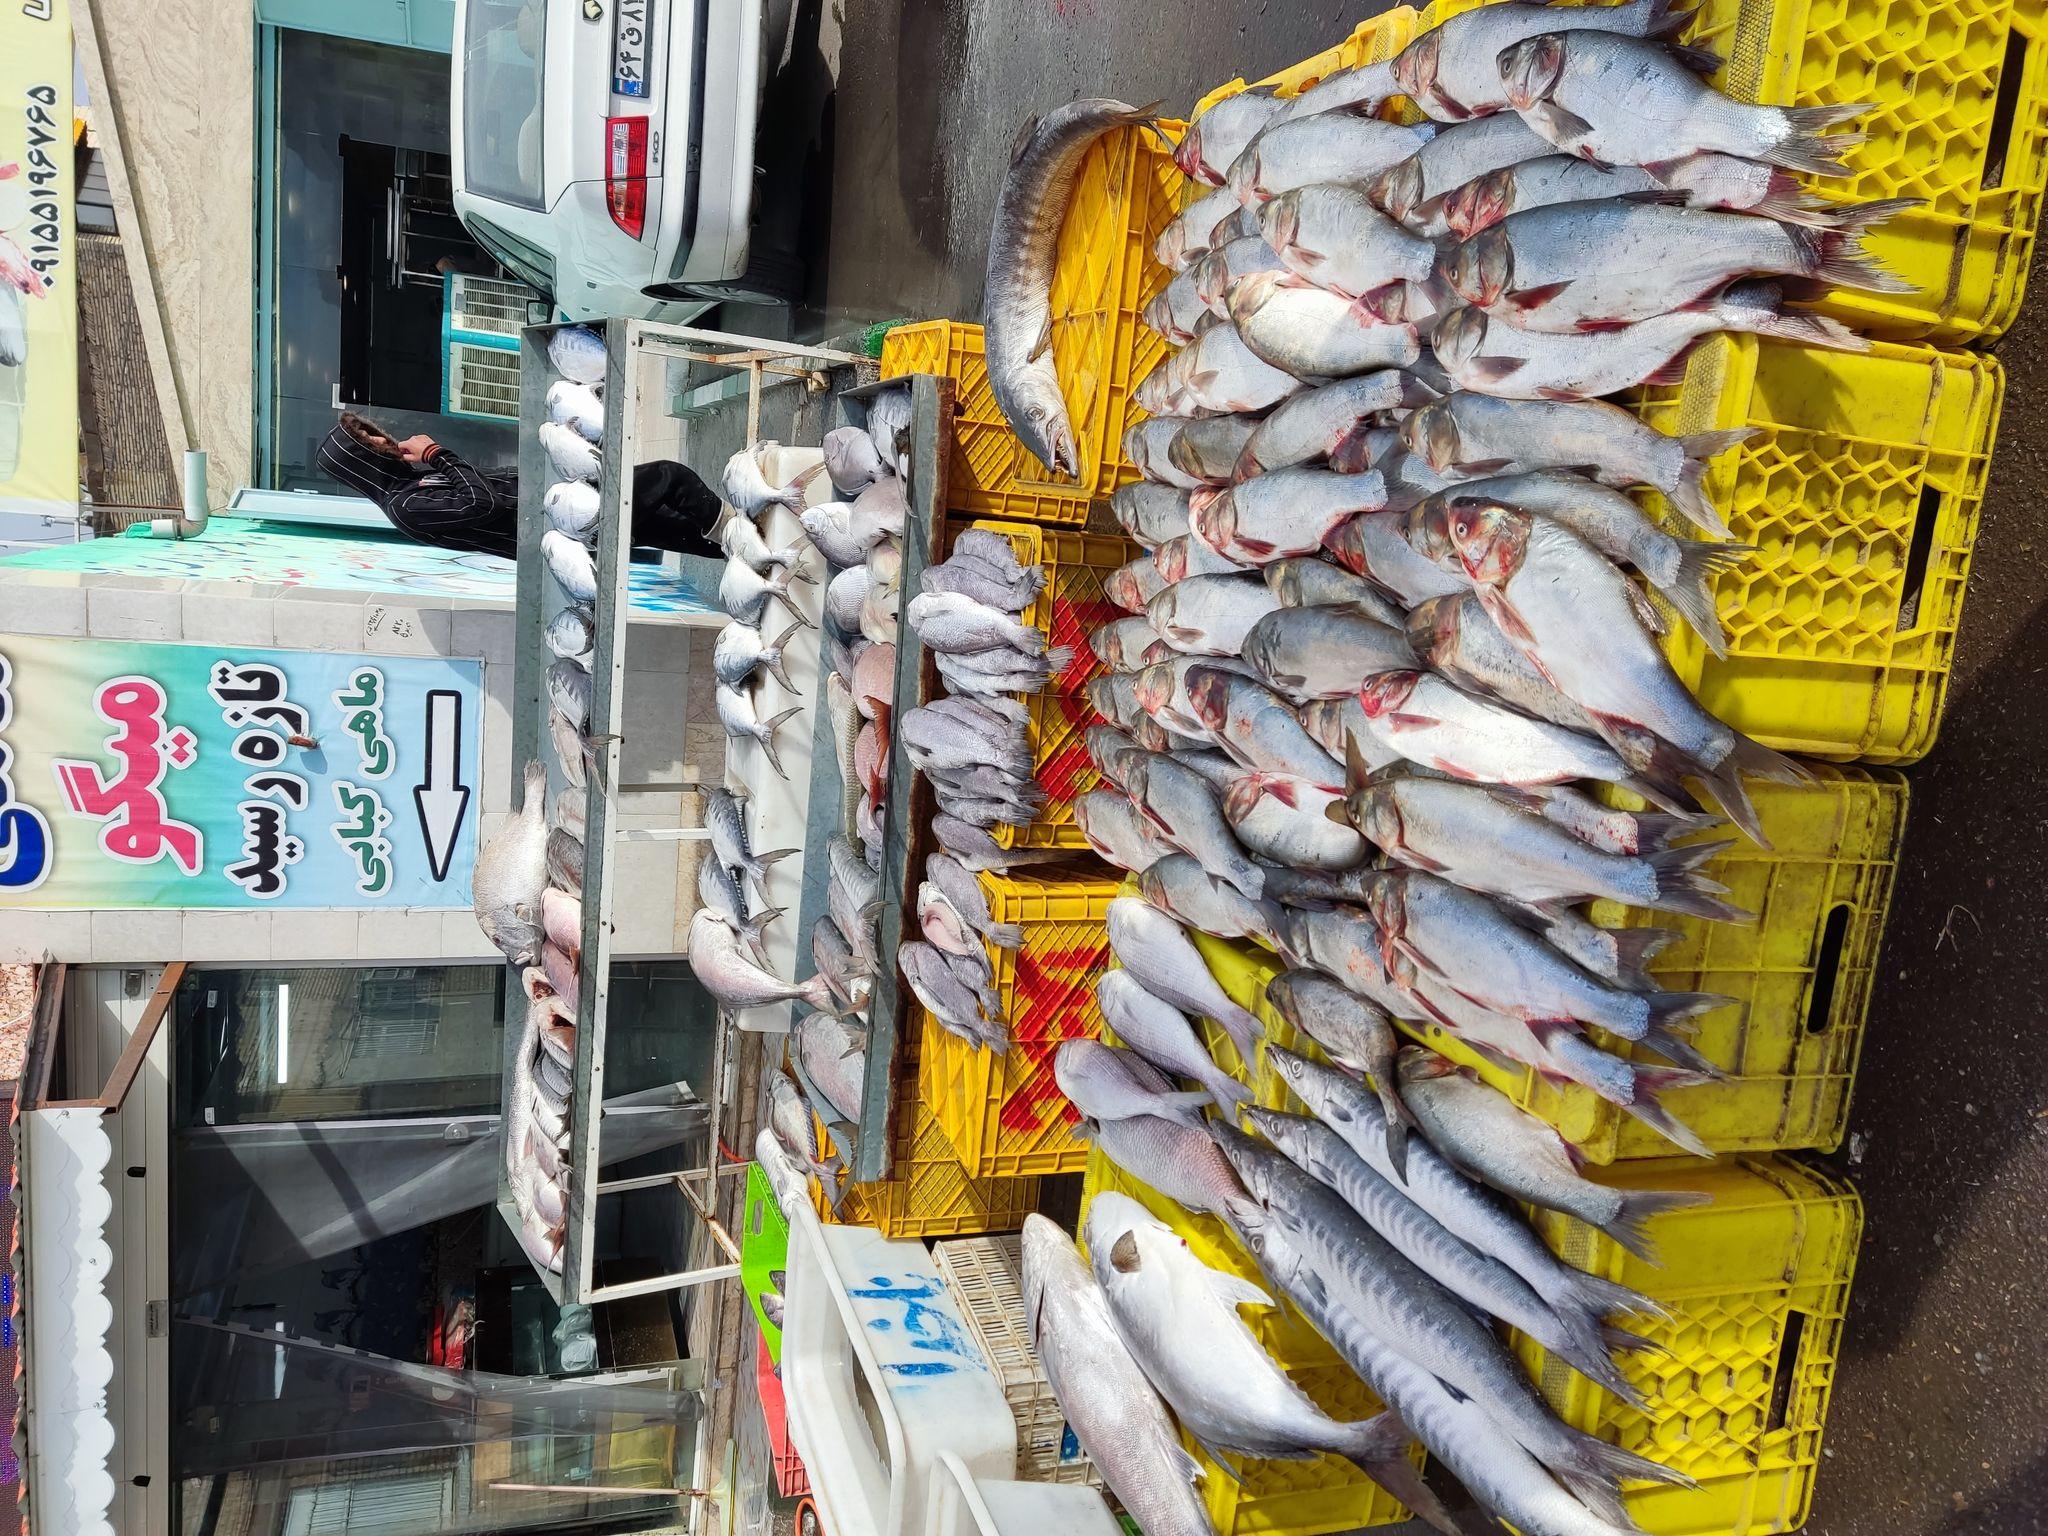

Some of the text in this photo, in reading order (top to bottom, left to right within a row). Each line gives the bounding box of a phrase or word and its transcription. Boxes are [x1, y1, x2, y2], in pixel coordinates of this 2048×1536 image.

[25, 84, 60, 288] ۰۹۱۵۵۱۹۶۷۶۵
[54, 679, 198, 872] میگو
[213, 665, 303, 762] تازه
[335, 671, 390, 893] ماهی کبابی
[229, 776, 303, 895] رسید
